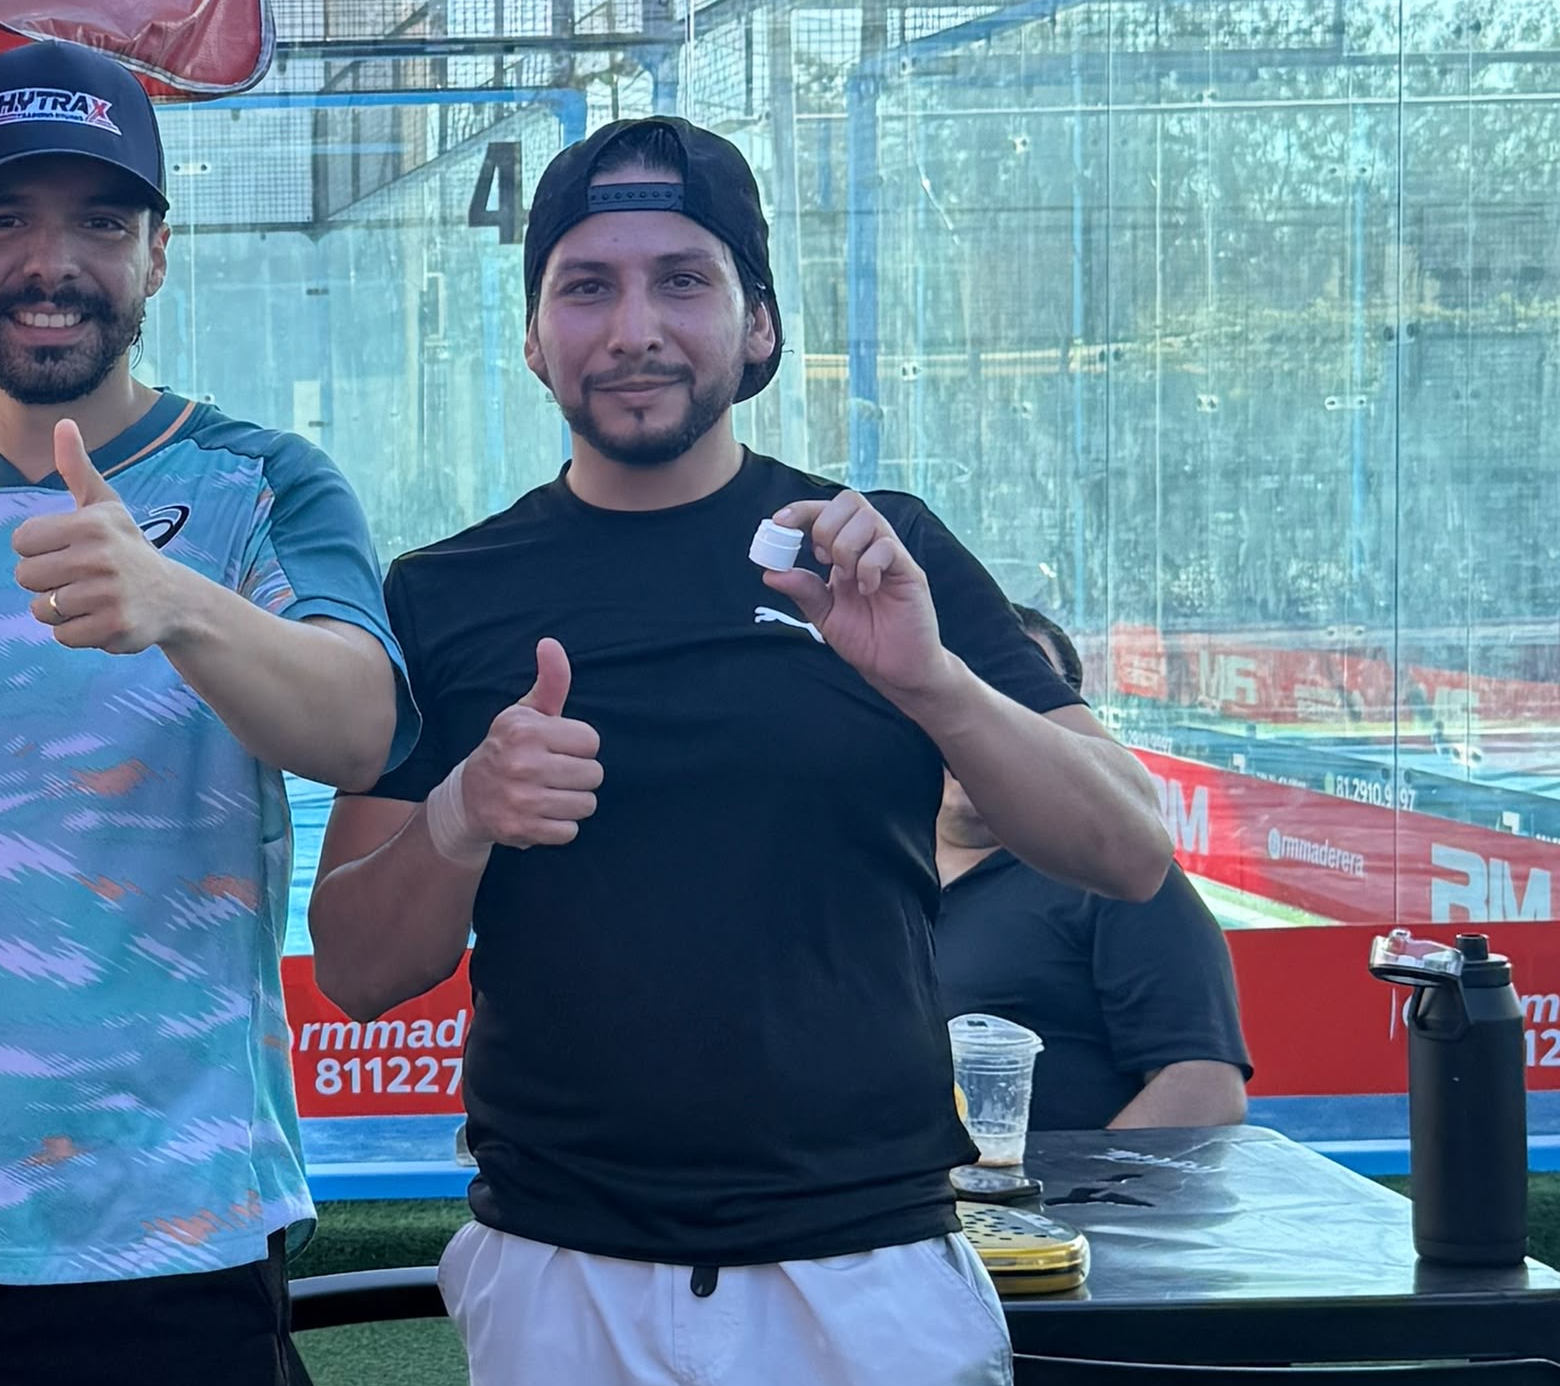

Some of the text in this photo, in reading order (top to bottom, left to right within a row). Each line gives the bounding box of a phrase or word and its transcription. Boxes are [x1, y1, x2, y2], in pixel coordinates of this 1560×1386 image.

[467, 141, 531, 245] 4
[299, 1009, 467, 1052] rmmad
[314, 1055, 464, 1096] 811227
